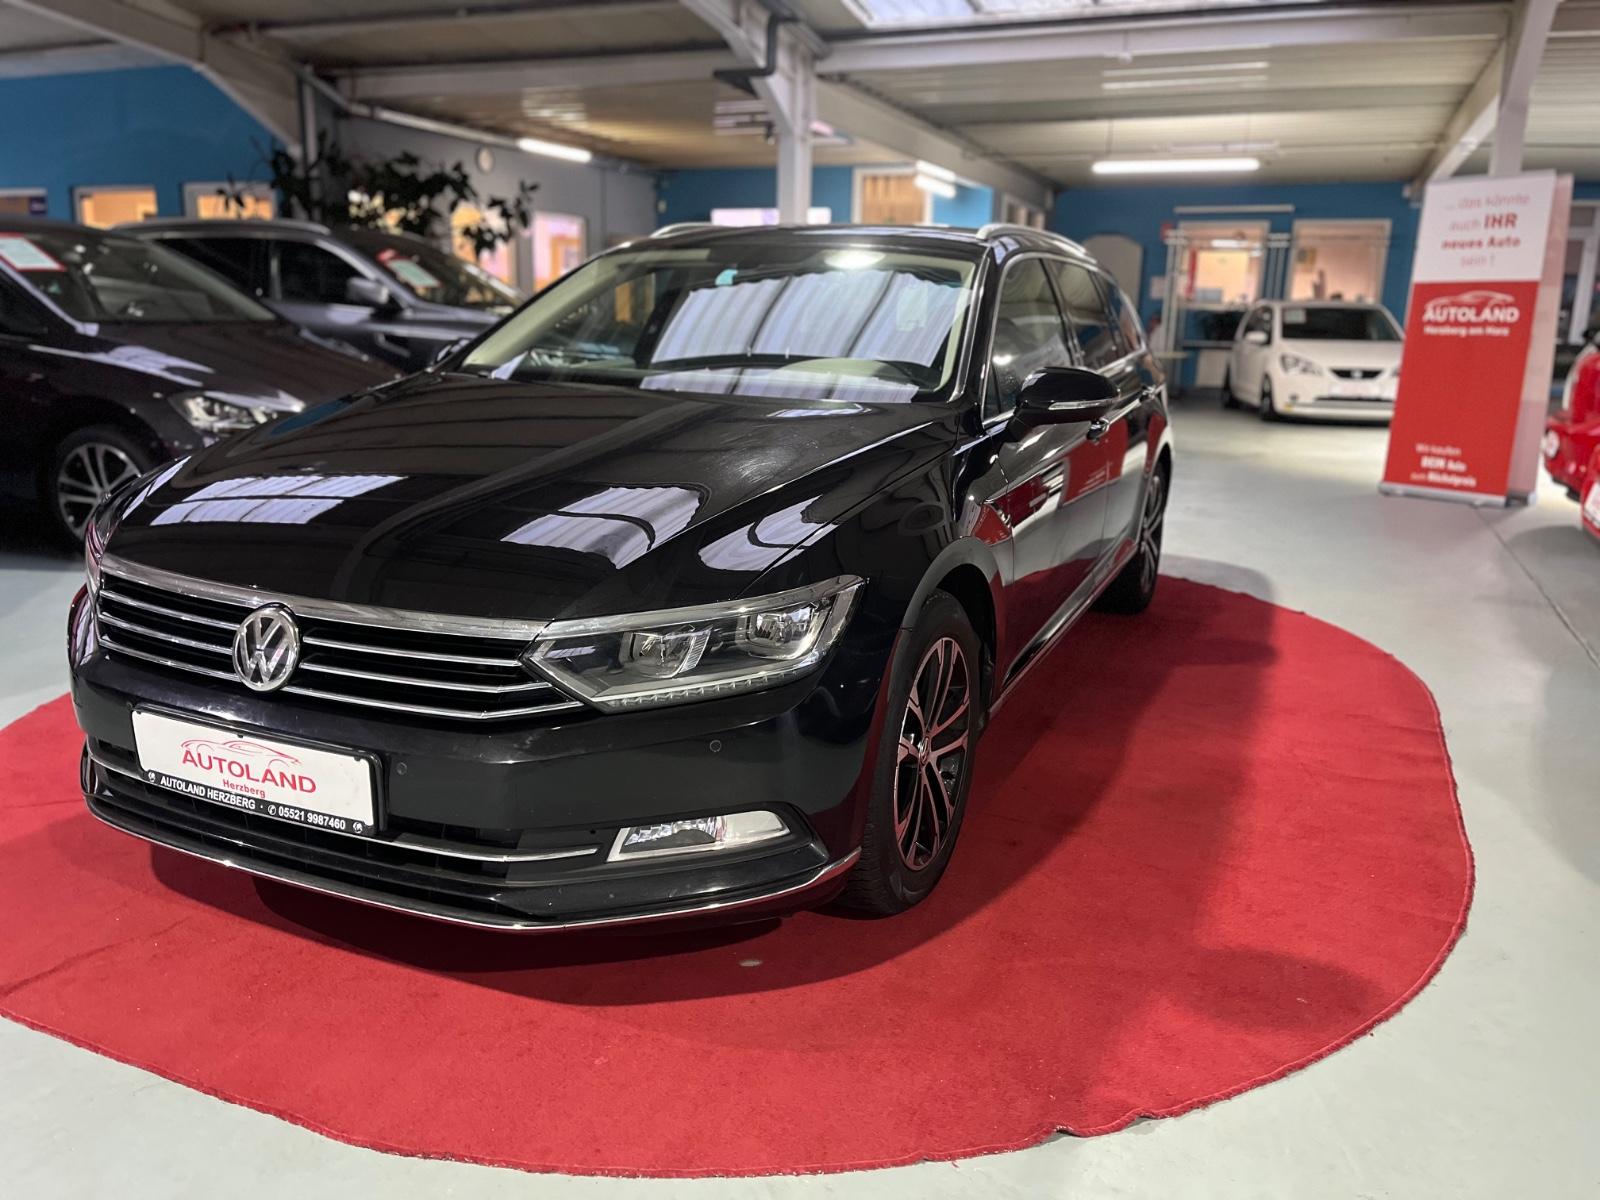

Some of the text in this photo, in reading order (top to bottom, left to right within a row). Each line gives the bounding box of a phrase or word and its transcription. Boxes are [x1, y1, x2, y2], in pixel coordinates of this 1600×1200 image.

[1484, 212, 1518, 229] IHR
[1441, 236, 1521, 250] neues Auto
[1422, 305, 1521, 323] AUTOLAND
[182, 749, 317, 794] AUTOLAND
[222, 778, 266, 799] Herzberg
[160, 775, 346, 830] AUTOLAND HERZBERG 05521 9987460
